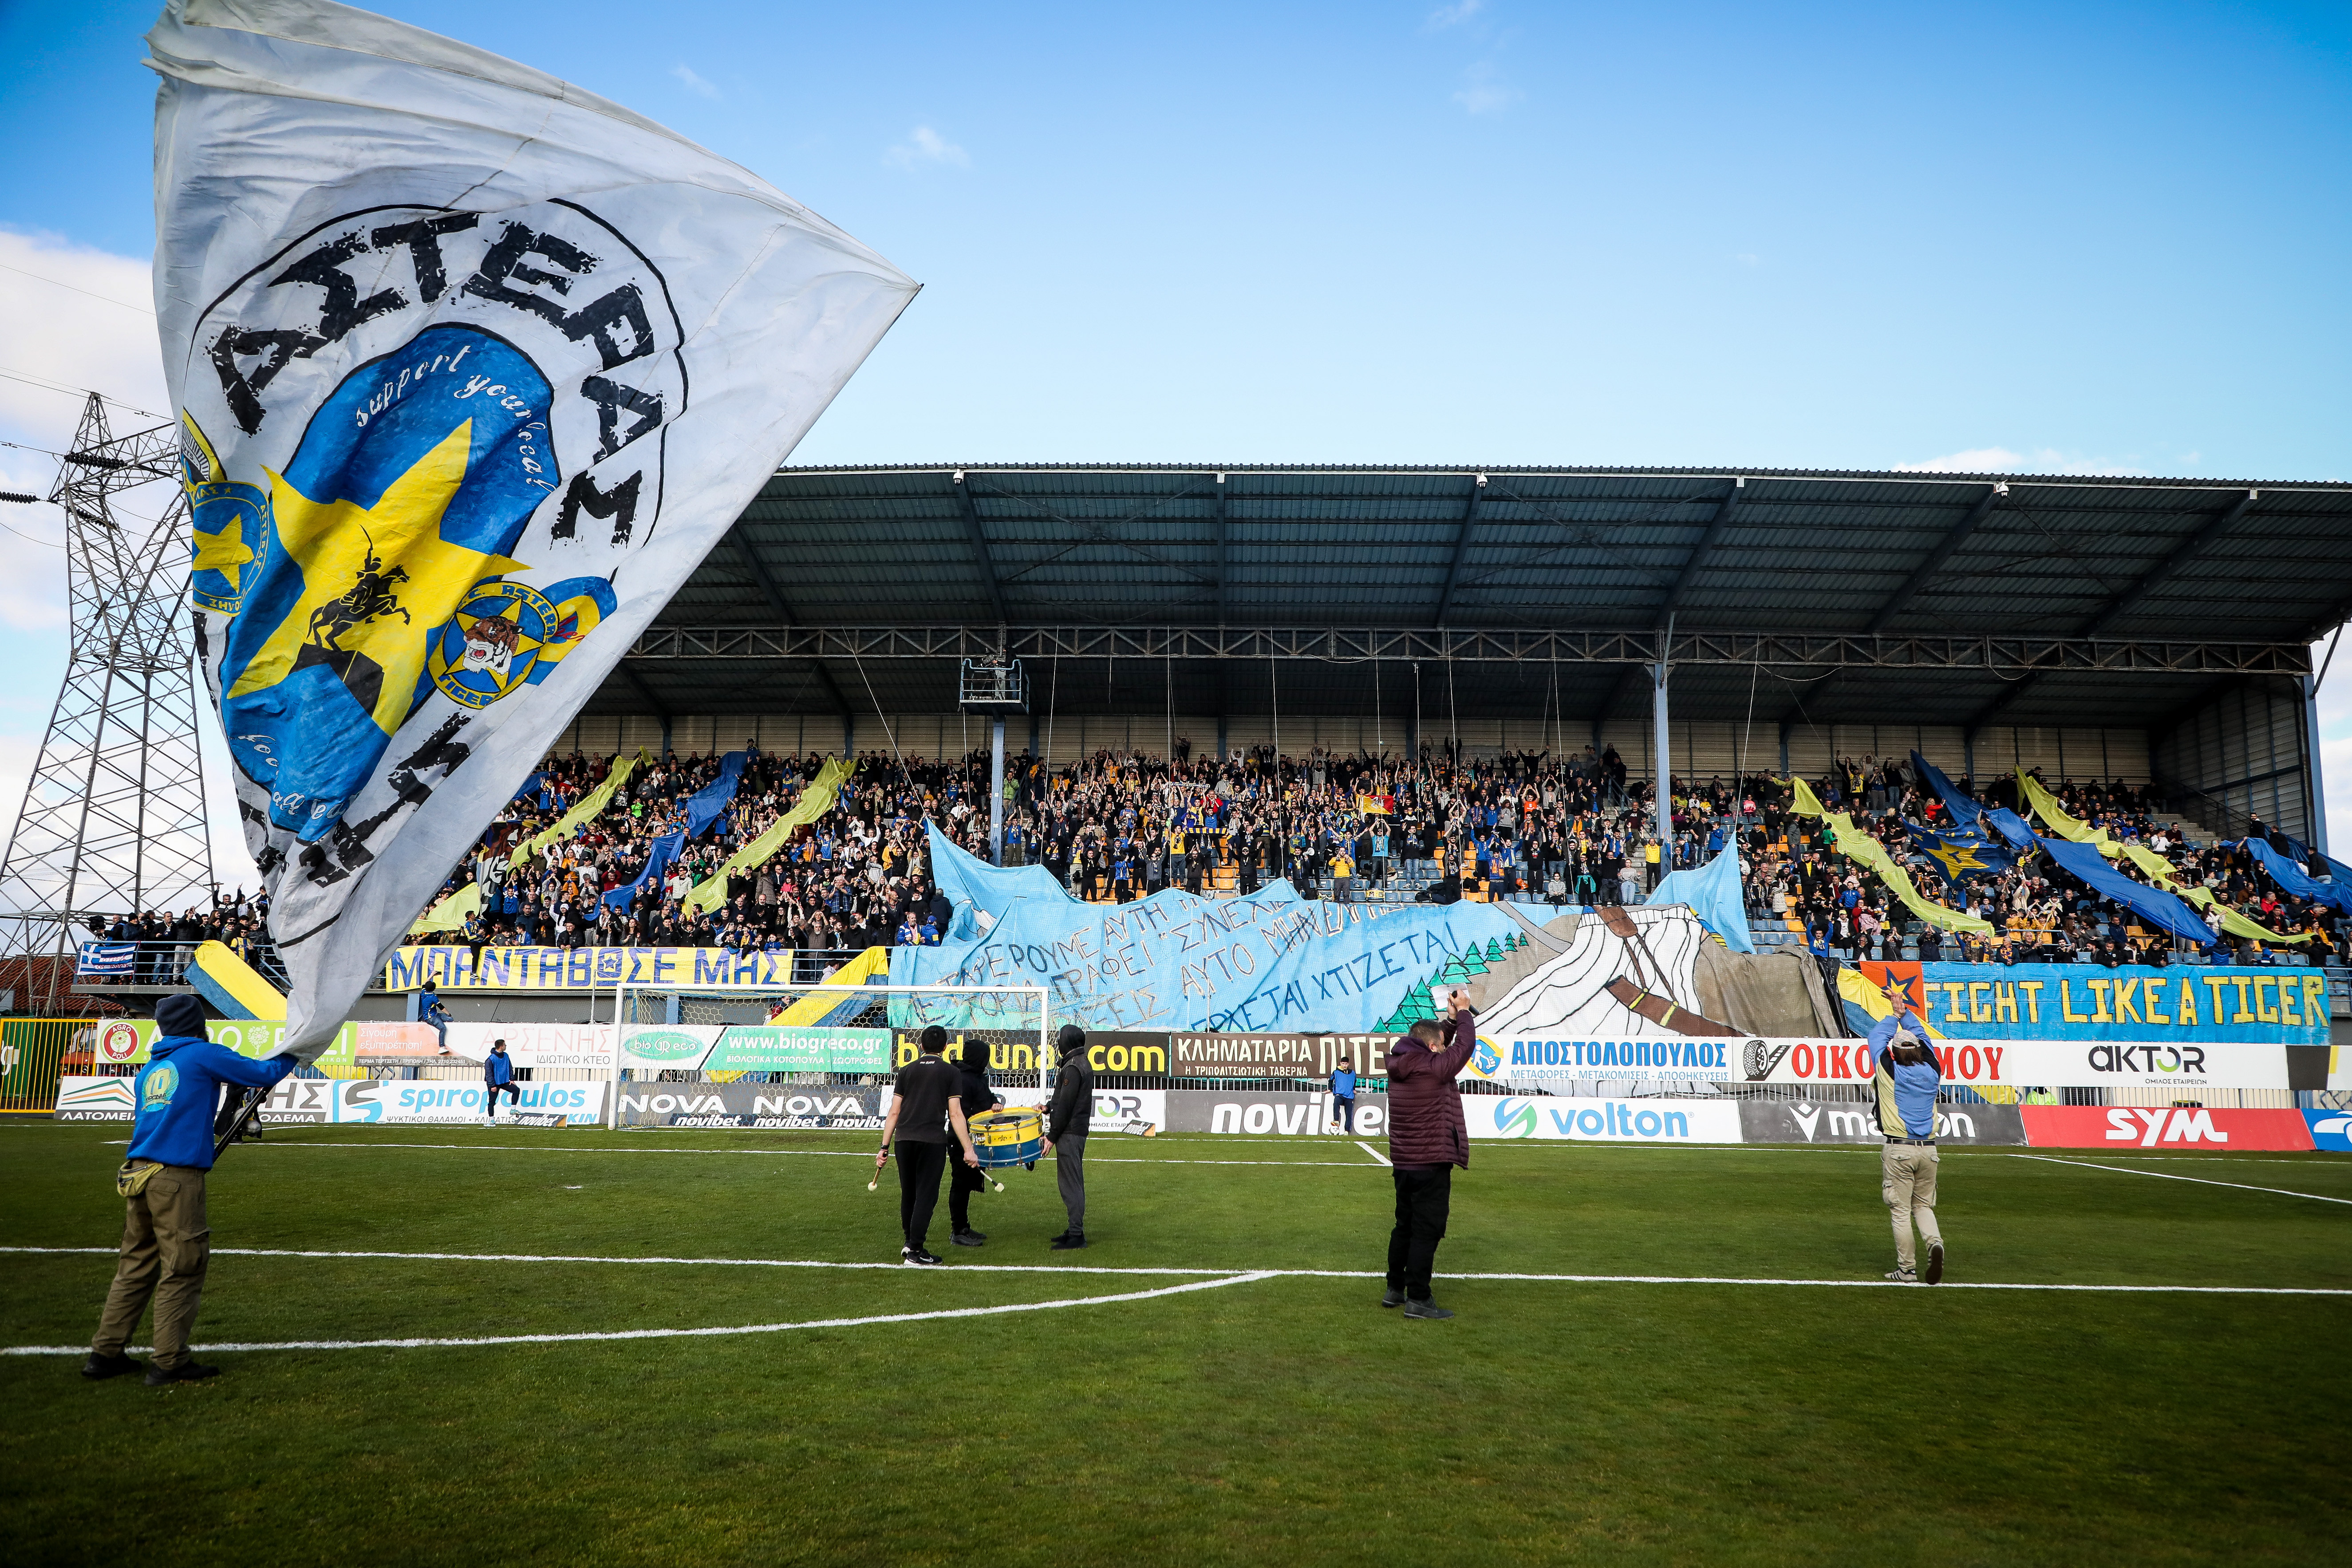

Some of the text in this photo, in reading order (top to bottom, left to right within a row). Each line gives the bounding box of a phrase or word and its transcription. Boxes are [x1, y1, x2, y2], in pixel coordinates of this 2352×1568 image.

[355, 345, 557, 494] support your local
[501, 585, 559, 636] ASTERA
[438, 675, 499, 707] TIGER
[694, 948, 789, 985] ΜΑΣ
[1181, 943, 1255, 999] ΑΥΤΟ
[1311, 921, 1460, 1000] ΧΤΙΖΕΤΑΙ
[1923, 975, 2326, 1028] FIGHT LIKE A TIGER
[112, 1024, 131, 1033] AGRO
[360, 1027, 397, 1039] Σίγουρη
[478, 1027, 612, 1053] ΑΡΣΕΝΗΣ
[359, 1040, 422, 1051] εξυπηρέτηση!
[728, 1032, 883, 1055] www.biogreco.gr
[1177, 1036, 1400, 1075] ΚΛΗΜΑΤΑΡΙΑ ΠΙΤΕ
[1511, 1041, 1727, 1067] ΑΠΟΣΤΟΛΟΠΟΥΛΟΣ
[537, 1055, 611, 1065] ΙΔΙΩΤΙΚΟ ΚΤΕΟ
[726, 1055, 771, 1063] ΒΙΟΛΟΓΙΚΑ
[773, 1056, 824, 1064] ΚΟΤΟΠΟΥΛΑ
[1185, 1066, 1308, 1077] Η ΤΡΙΠΟΛΙΤΣΙΩΤΙΚΗ ΤΑΒΕΡΝΑ
[1792, 1043, 2003, 1080] ΟΙΚΟΜΟΥ
[1511, 1069, 1570, 1079] ΜΕΤΑΦΟΡΕΣ
[1579, 1070, 1649, 1081] ΜΕΤΑΚΟΜΙΣΕΙΣ
[1657, 1071, 1728, 1082] ΑΠΟΘΗΚΕΥΣΕΙΣ
[617, 1094, 864, 1116] NOVA NOVA
[1090, 1096, 1141, 1118] TOR
[1210, 1092, 1389, 1136] novibe
[260, 1114, 316, 1123] ΟΔΕΜΑ
[517, 1113, 560, 1127] novibet
[675, 1114, 742, 1126] novibet
[753, 1115, 821, 1127] novibet
[1549, 1102, 1689, 1137] volton
[1827, 1110, 1976, 1138] maon
[2105, 1108, 2228, 1147] SYM
